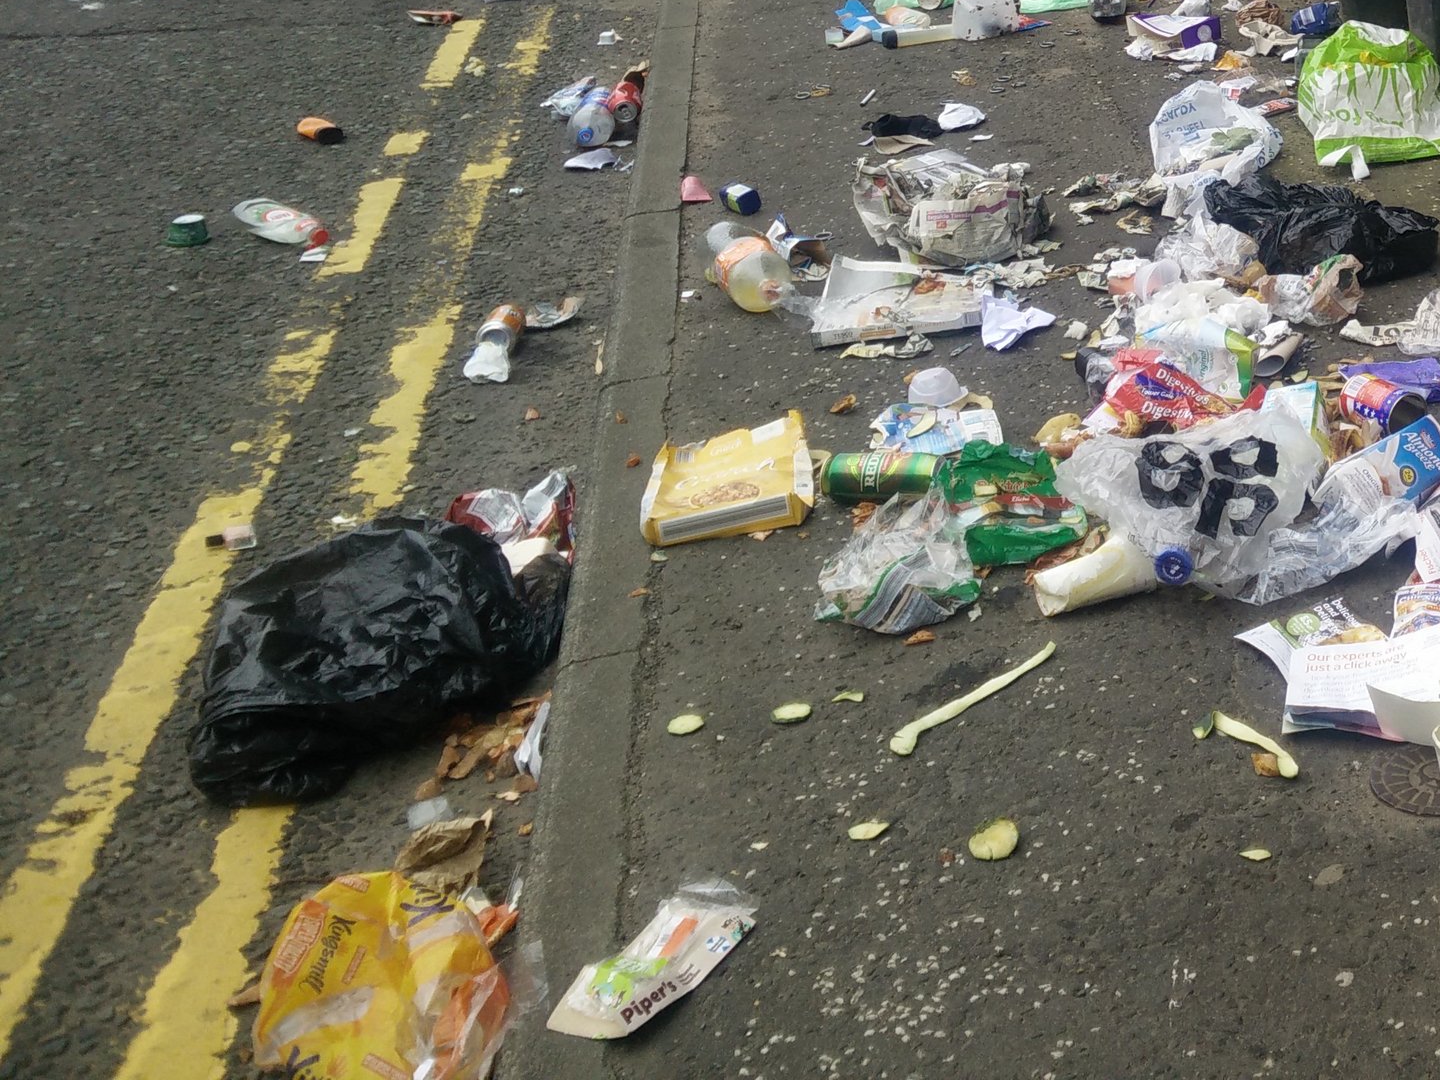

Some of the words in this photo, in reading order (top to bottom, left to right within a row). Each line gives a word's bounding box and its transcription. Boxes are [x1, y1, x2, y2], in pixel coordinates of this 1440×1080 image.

[1156, 368, 1210, 405] Digestives
[1403, 442, 1436, 472] Breeze
[1322, 602, 1339, 619] and
[1305, 662, 1330, 674] just
[1332, 664, 1343, 672] a
[1343, 658, 1372, 670] click
[1374, 652, 1408, 668] away
[1306, 652, 1331, 662] Our
[1332, 650, 1383, 664] experts
[1384, 644, 1406, 656] are
[299, 915, 357, 995] Kingsmill
[620, 980, 678, 1026] Piper's
